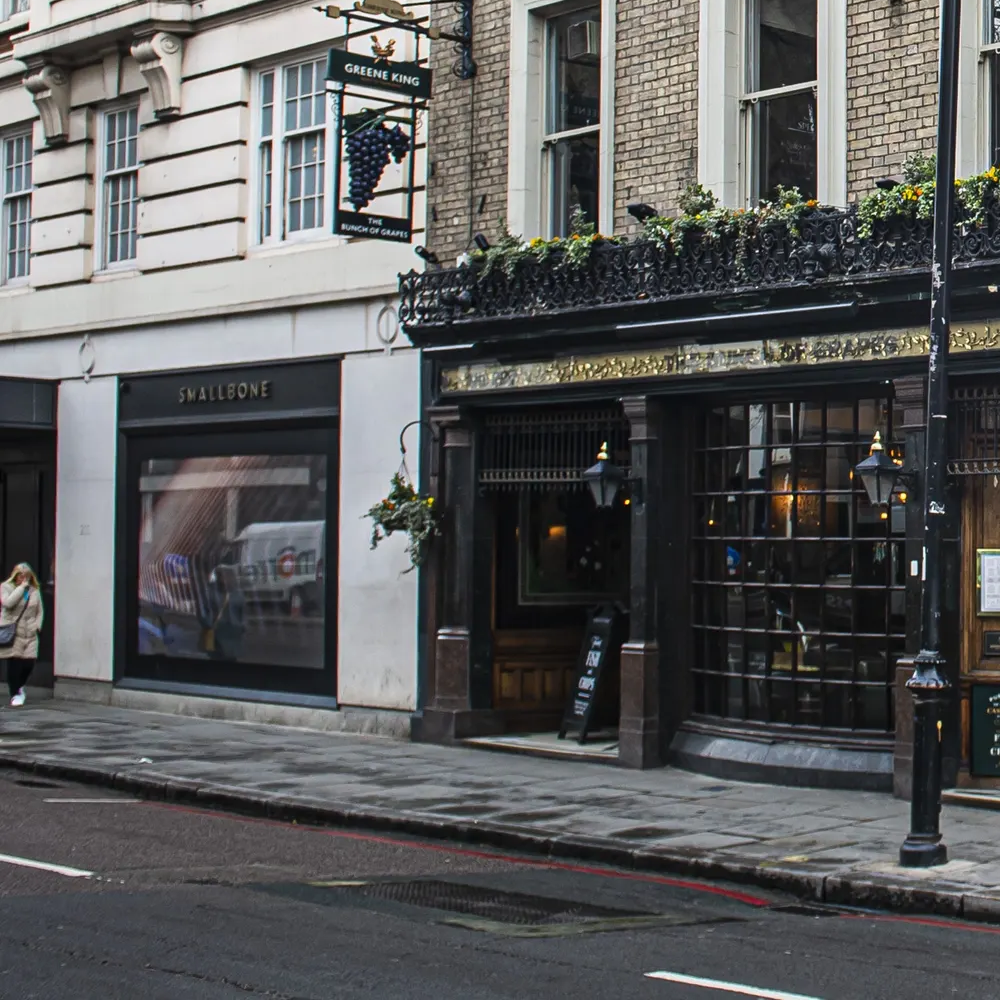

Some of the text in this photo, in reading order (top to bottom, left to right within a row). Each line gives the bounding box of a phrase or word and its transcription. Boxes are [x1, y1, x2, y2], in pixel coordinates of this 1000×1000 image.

[344, 63, 389, 80] GREENE
[391, 72, 420, 87] KING
[341, 223, 368, 233] BUNCH
[381, 228, 409, 239] GRAPES
[368, 217, 383, 226] THE
[179, 380, 269, 403] SMALLBONE
